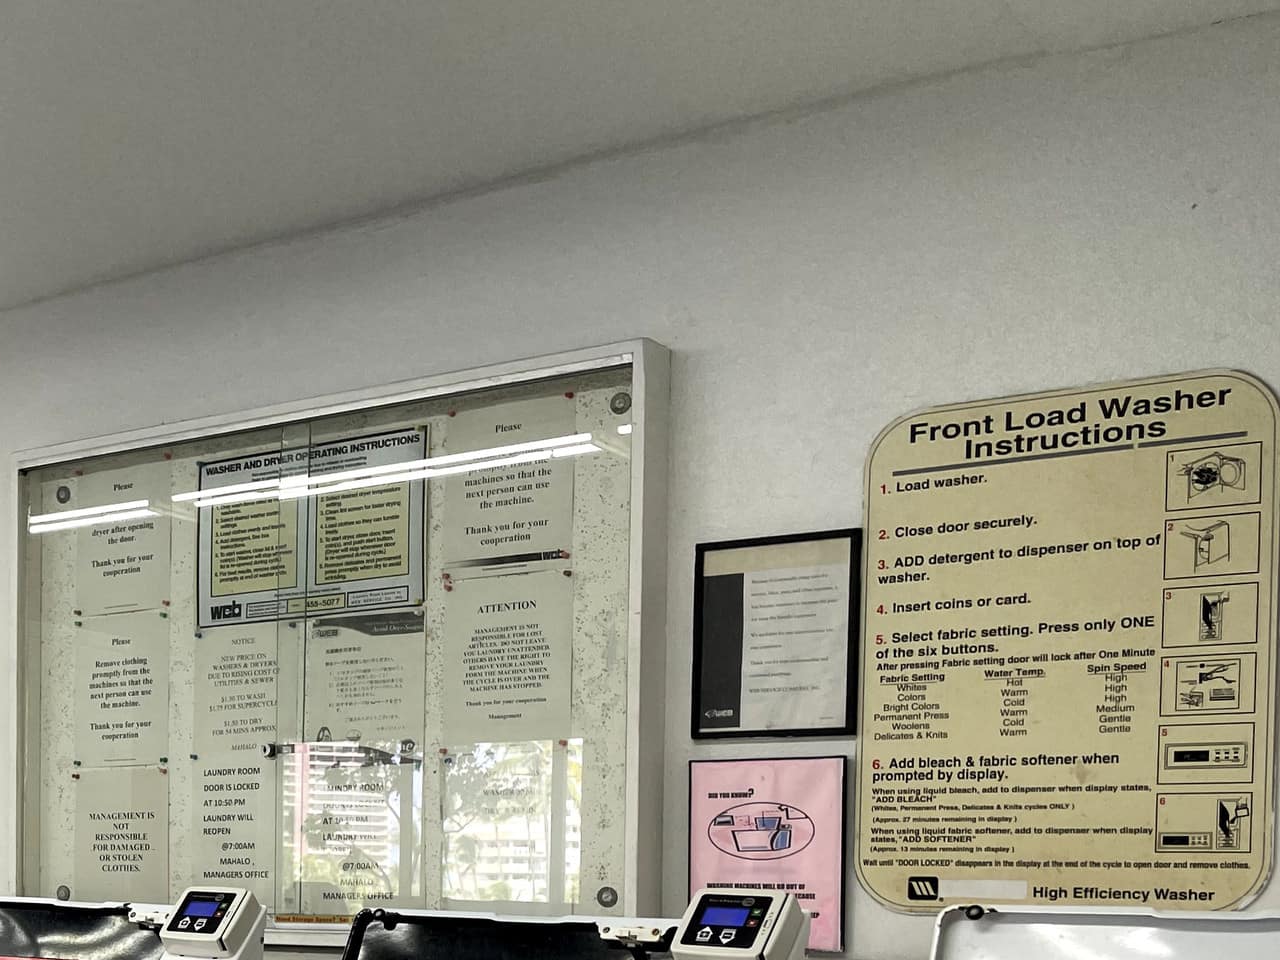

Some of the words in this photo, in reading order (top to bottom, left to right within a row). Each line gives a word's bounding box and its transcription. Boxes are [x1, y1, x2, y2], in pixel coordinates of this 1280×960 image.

[910, 415, 993, 443] Front
[1006, 402, 1086, 431] Load
[1099, 388, 1231, 419] Washer
[966, 420, 1166, 458] Instructions
[206, 460, 242, 476] WASHER
[244, 458, 262, 470] AND
[264, 454, 294, 467] DRYER
[296, 446, 348, 462] OPERATING
[350, 435, 420, 453] INSTRUCTIONS
[465, 476, 503, 487] machines
[518, 471, 535, 479] that
[881, 484, 891, 494] 1.
[896, 479, 930, 492] Load
[934, 474, 987, 488] washer.
[466, 489, 483, 499] next
[487, 487, 514, 498] person
[517, 483, 533, 491] can
[879, 530, 889, 540] 2.
[895, 527, 933, 537] Close
[938, 523, 969, 533] door
[974, 515, 1037, 530] securely.
[878, 560, 889, 569] 3.
[895, 556, 924, 568] ADD
[929, 550, 994, 565] detergent
[999, 549, 1012, 559] to
[1017, 543, 1089, 557] dispenser
[1093, 540, 1112, 550] on
[1117, 538, 1140, 549] top
[1146, 534, 1160, 545] of
[878, 572, 930, 584] washer.
[478, 600, 536, 614] ATTENTION
[877, 605, 887, 615] 4.
[893, 601, 930, 613] Insert
[935, 599, 972, 610] coins
[977, 599, 991, 607] or
[996, 593, 1031, 605] card.
[876, 635, 887, 645] 5.
[892, 632, 933, 643] Select
[938, 628, 976, 640] fabric
[981, 625, 1033, 637] setting.
[1039, 622, 1079, 633] Press
[1084, 619, 1115, 632] only
[1121, 616, 1154, 628] ONE
[876, 648, 888, 659] of
[893, 648, 913, 658] the
[918, 646, 937, 656] six
[942, 644, 998, 655] buttons.
[901, 661, 939, 671] pressing
[942, 659, 970, 667] Fabric
[973, 656, 1004, 666] setting
[1032, 654, 1048, 662] will
[1052, 653, 1071, 661] lock
[1122, 648, 1155, 657] Minute
[880, 675, 909, 683] Fabric
[912, 674, 945, 682] Setting
[1088, 664, 1110, 673] Spin
[1114, 662, 1146, 672] Speed
[1105, 674, 1127, 682] High
[1105, 684, 1127, 692] High
[884, 704, 908, 712] Bright
[1105, 694, 1127, 703] High
[874, 713, 920, 721] Permanent
[1003, 718, 1024, 726] Cold
[1099, 714, 1131, 722] Gentle
[1000, 728, 1027, 736] Warm
[1099, 725, 1131, 733] Gentle
[873, 760, 884, 769] 6.
[889, 758, 914, 769] Add
[919, 757, 961, 768] bleach
[966, 757, 974, 767] &
[980, 755, 1017, 766] fabric
[1022, 754, 1078, 766] softener
[1083, 753, 1119, 764] when
[873, 770, 933, 783] prompted
[938, 770, 953, 782] by
[957, 768, 1008, 782] display.
[233, 783, 259, 791] LOCKED
[89, 812, 146, 820] MANAGEMENT
[1033, 887, 1067, 900] High
[1074, 887, 1149, 902] Efficiency
[1155, 888, 1214, 902] Washer
